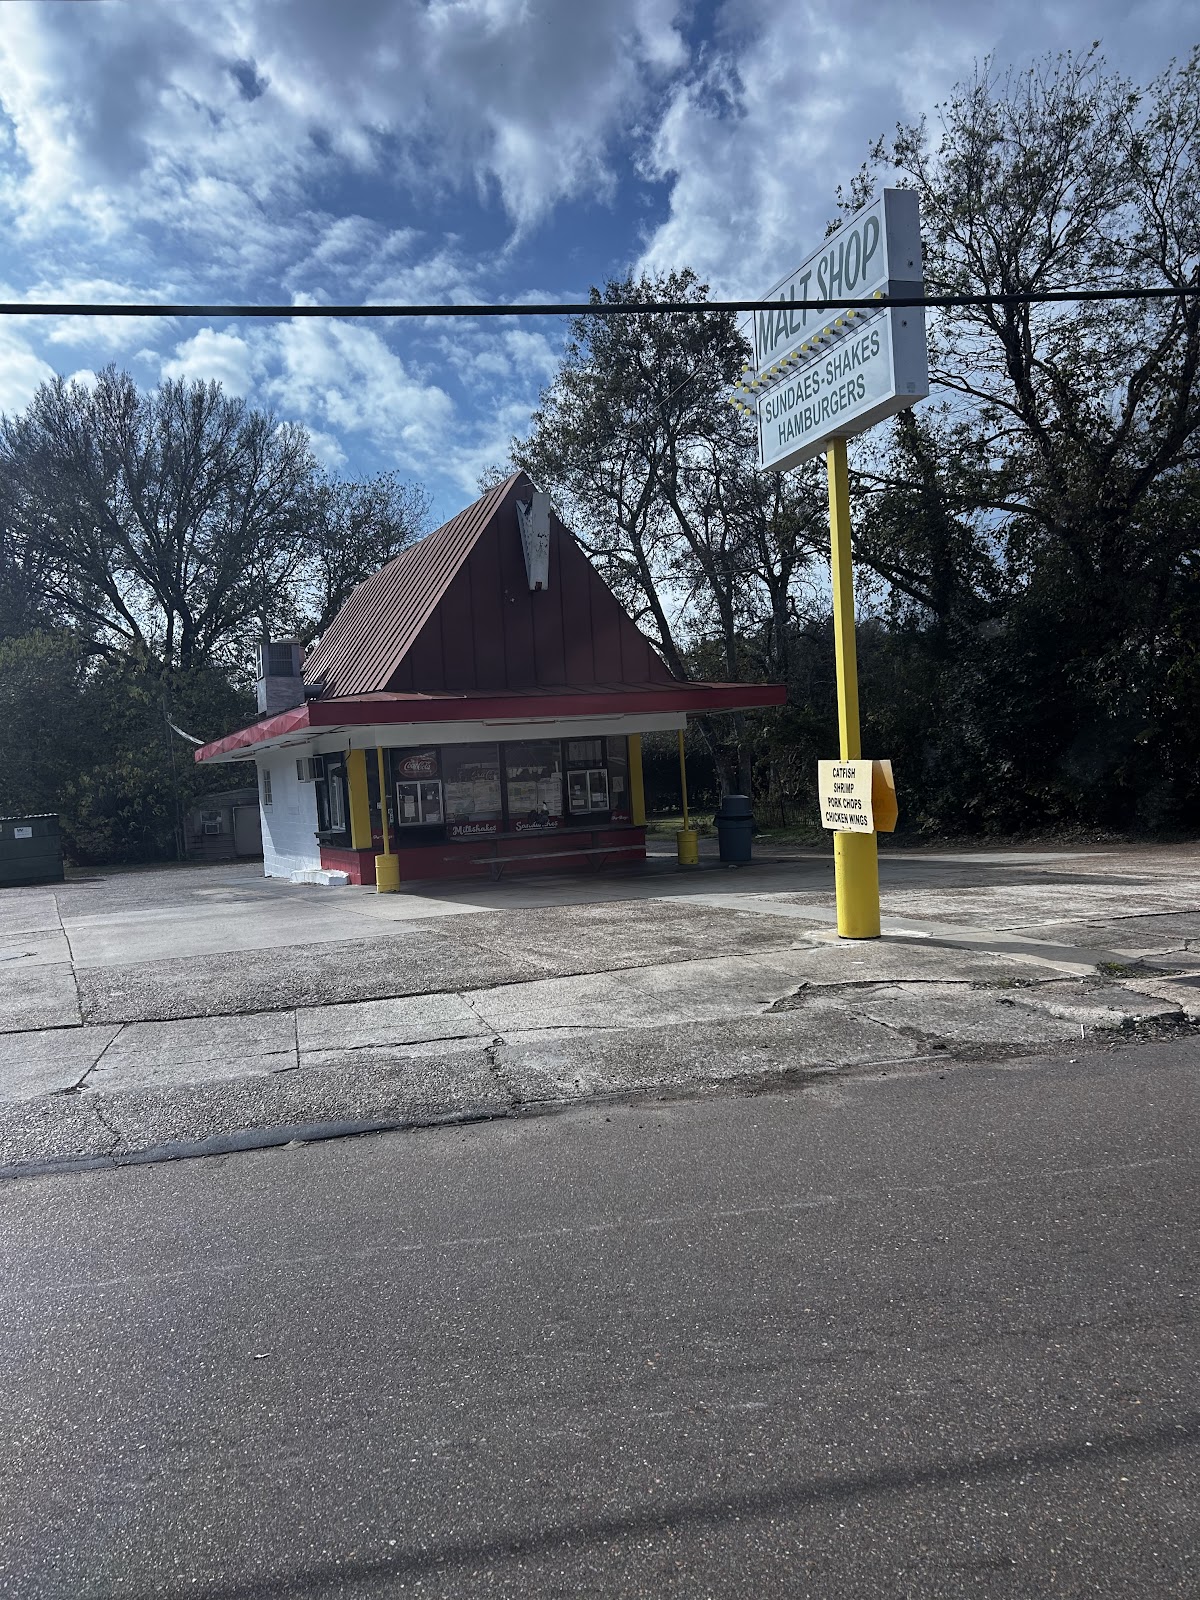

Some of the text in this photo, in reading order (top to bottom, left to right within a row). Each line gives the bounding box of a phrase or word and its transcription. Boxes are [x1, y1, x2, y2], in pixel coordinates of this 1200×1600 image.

[758, 215, 880, 359] MALT SHOP
[765, 330, 880, 424] SUNDAES-SHAKES
[778, 373, 866, 445] HAMBURGERS
[832, 768, 856, 778] CATFISH
[833, 782, 855, 793] SHRIMP
[827, 797, 862, 809] PORK CHOPS
[826, 812, 868, 826] CHICKEN WINGS
[453, 823, 497, 836] Milkshakes
